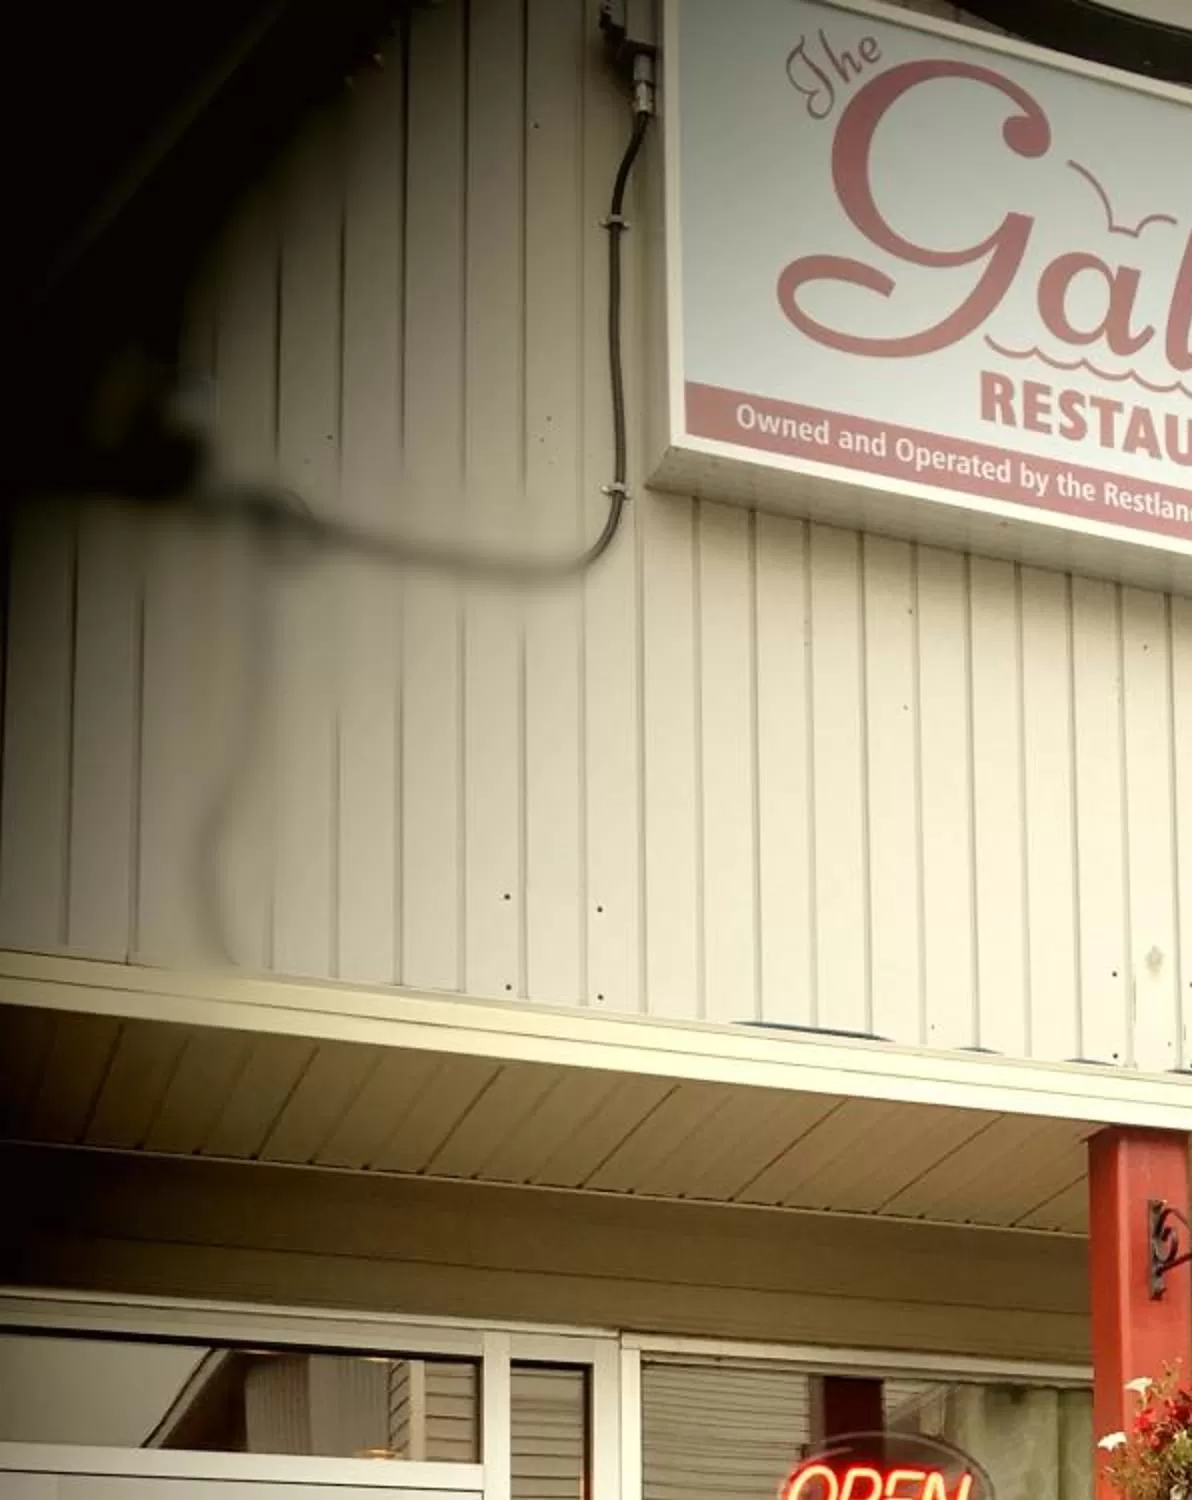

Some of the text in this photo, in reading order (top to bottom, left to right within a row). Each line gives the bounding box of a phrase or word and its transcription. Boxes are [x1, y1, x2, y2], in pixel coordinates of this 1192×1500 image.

[786, 28, 882, 120] The
[736, 403, 830, 445] Owned
[838, 432, 888, 457] and
[895, 438, 1012, 484] Operated
[1019, 461, 1049, 497] by
[1056, 473, 1097, 501] the
